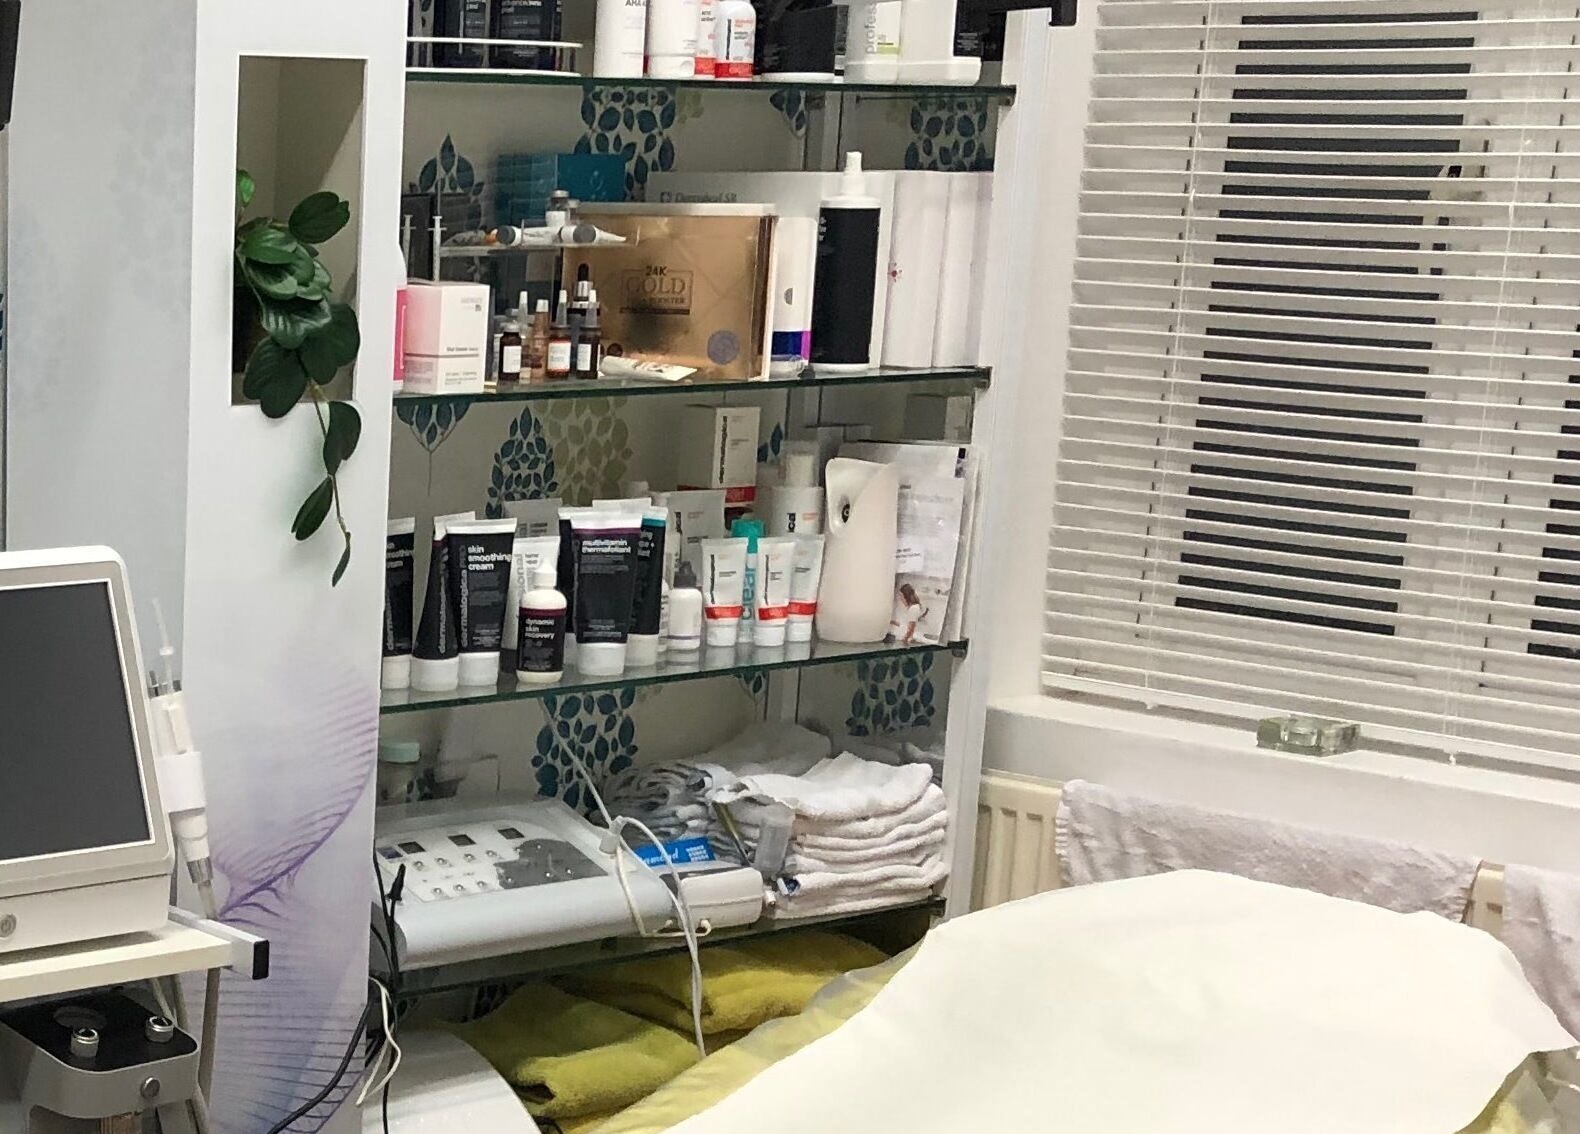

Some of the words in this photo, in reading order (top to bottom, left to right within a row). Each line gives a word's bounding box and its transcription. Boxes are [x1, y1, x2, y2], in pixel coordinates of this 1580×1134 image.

[645, 265, 668, 276] 24K
[626, 276, 686, 295] GOLD
[468, 544, 485, 553] skin
[468, 553, 512, 562] smoothing
[468, 563, 494, 571] cream
